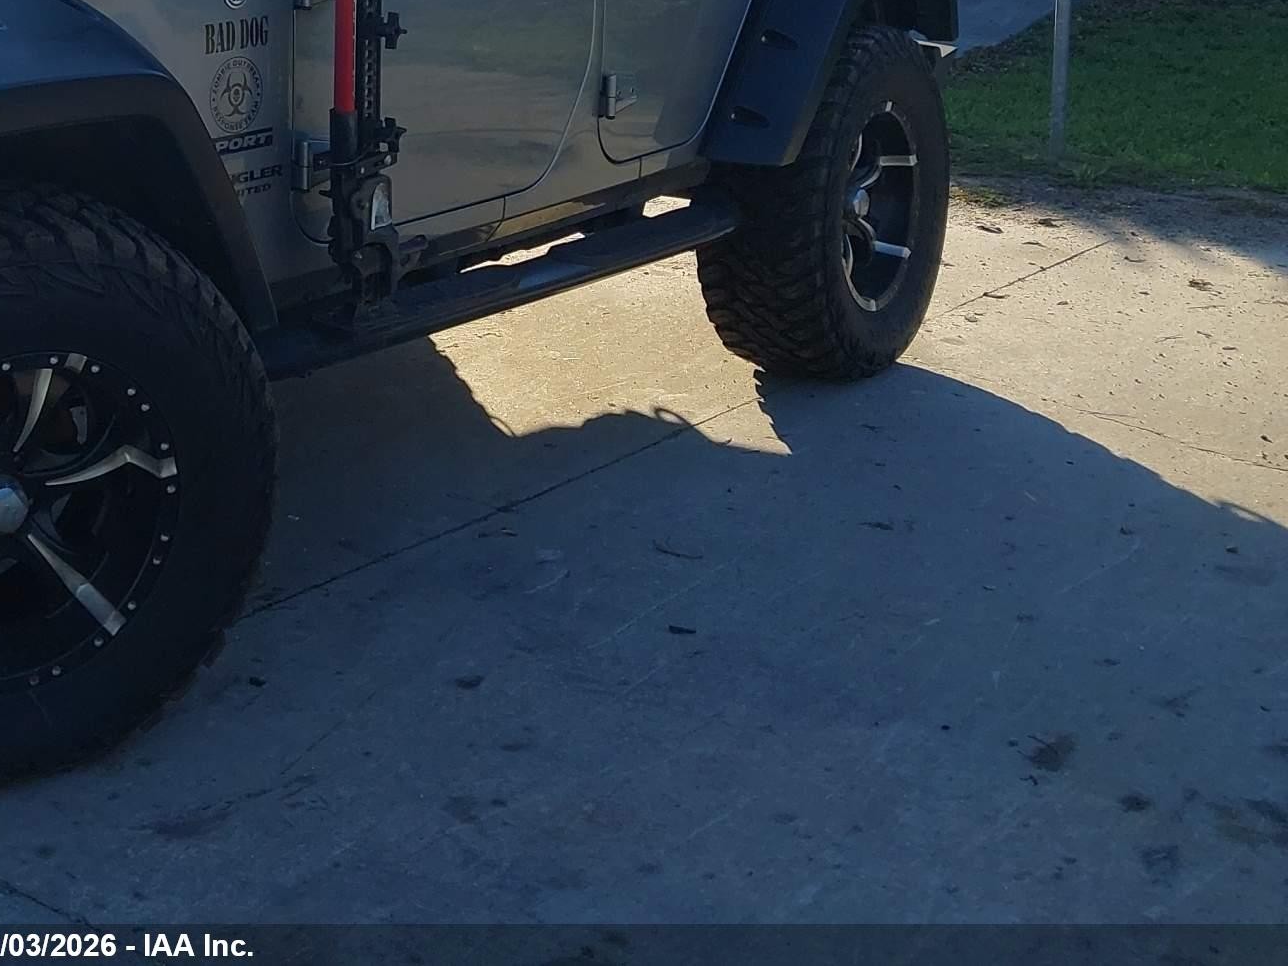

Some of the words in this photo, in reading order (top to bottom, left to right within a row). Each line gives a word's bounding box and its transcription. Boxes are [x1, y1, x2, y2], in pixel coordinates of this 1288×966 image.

[205, 21, 236, 55] BAD
[239, 16, 270, 50] DOG
[215, 132, 267, 153] PORT
[236, 163, 283, 183] GLER
[239, 183, 272, 196] ITED
